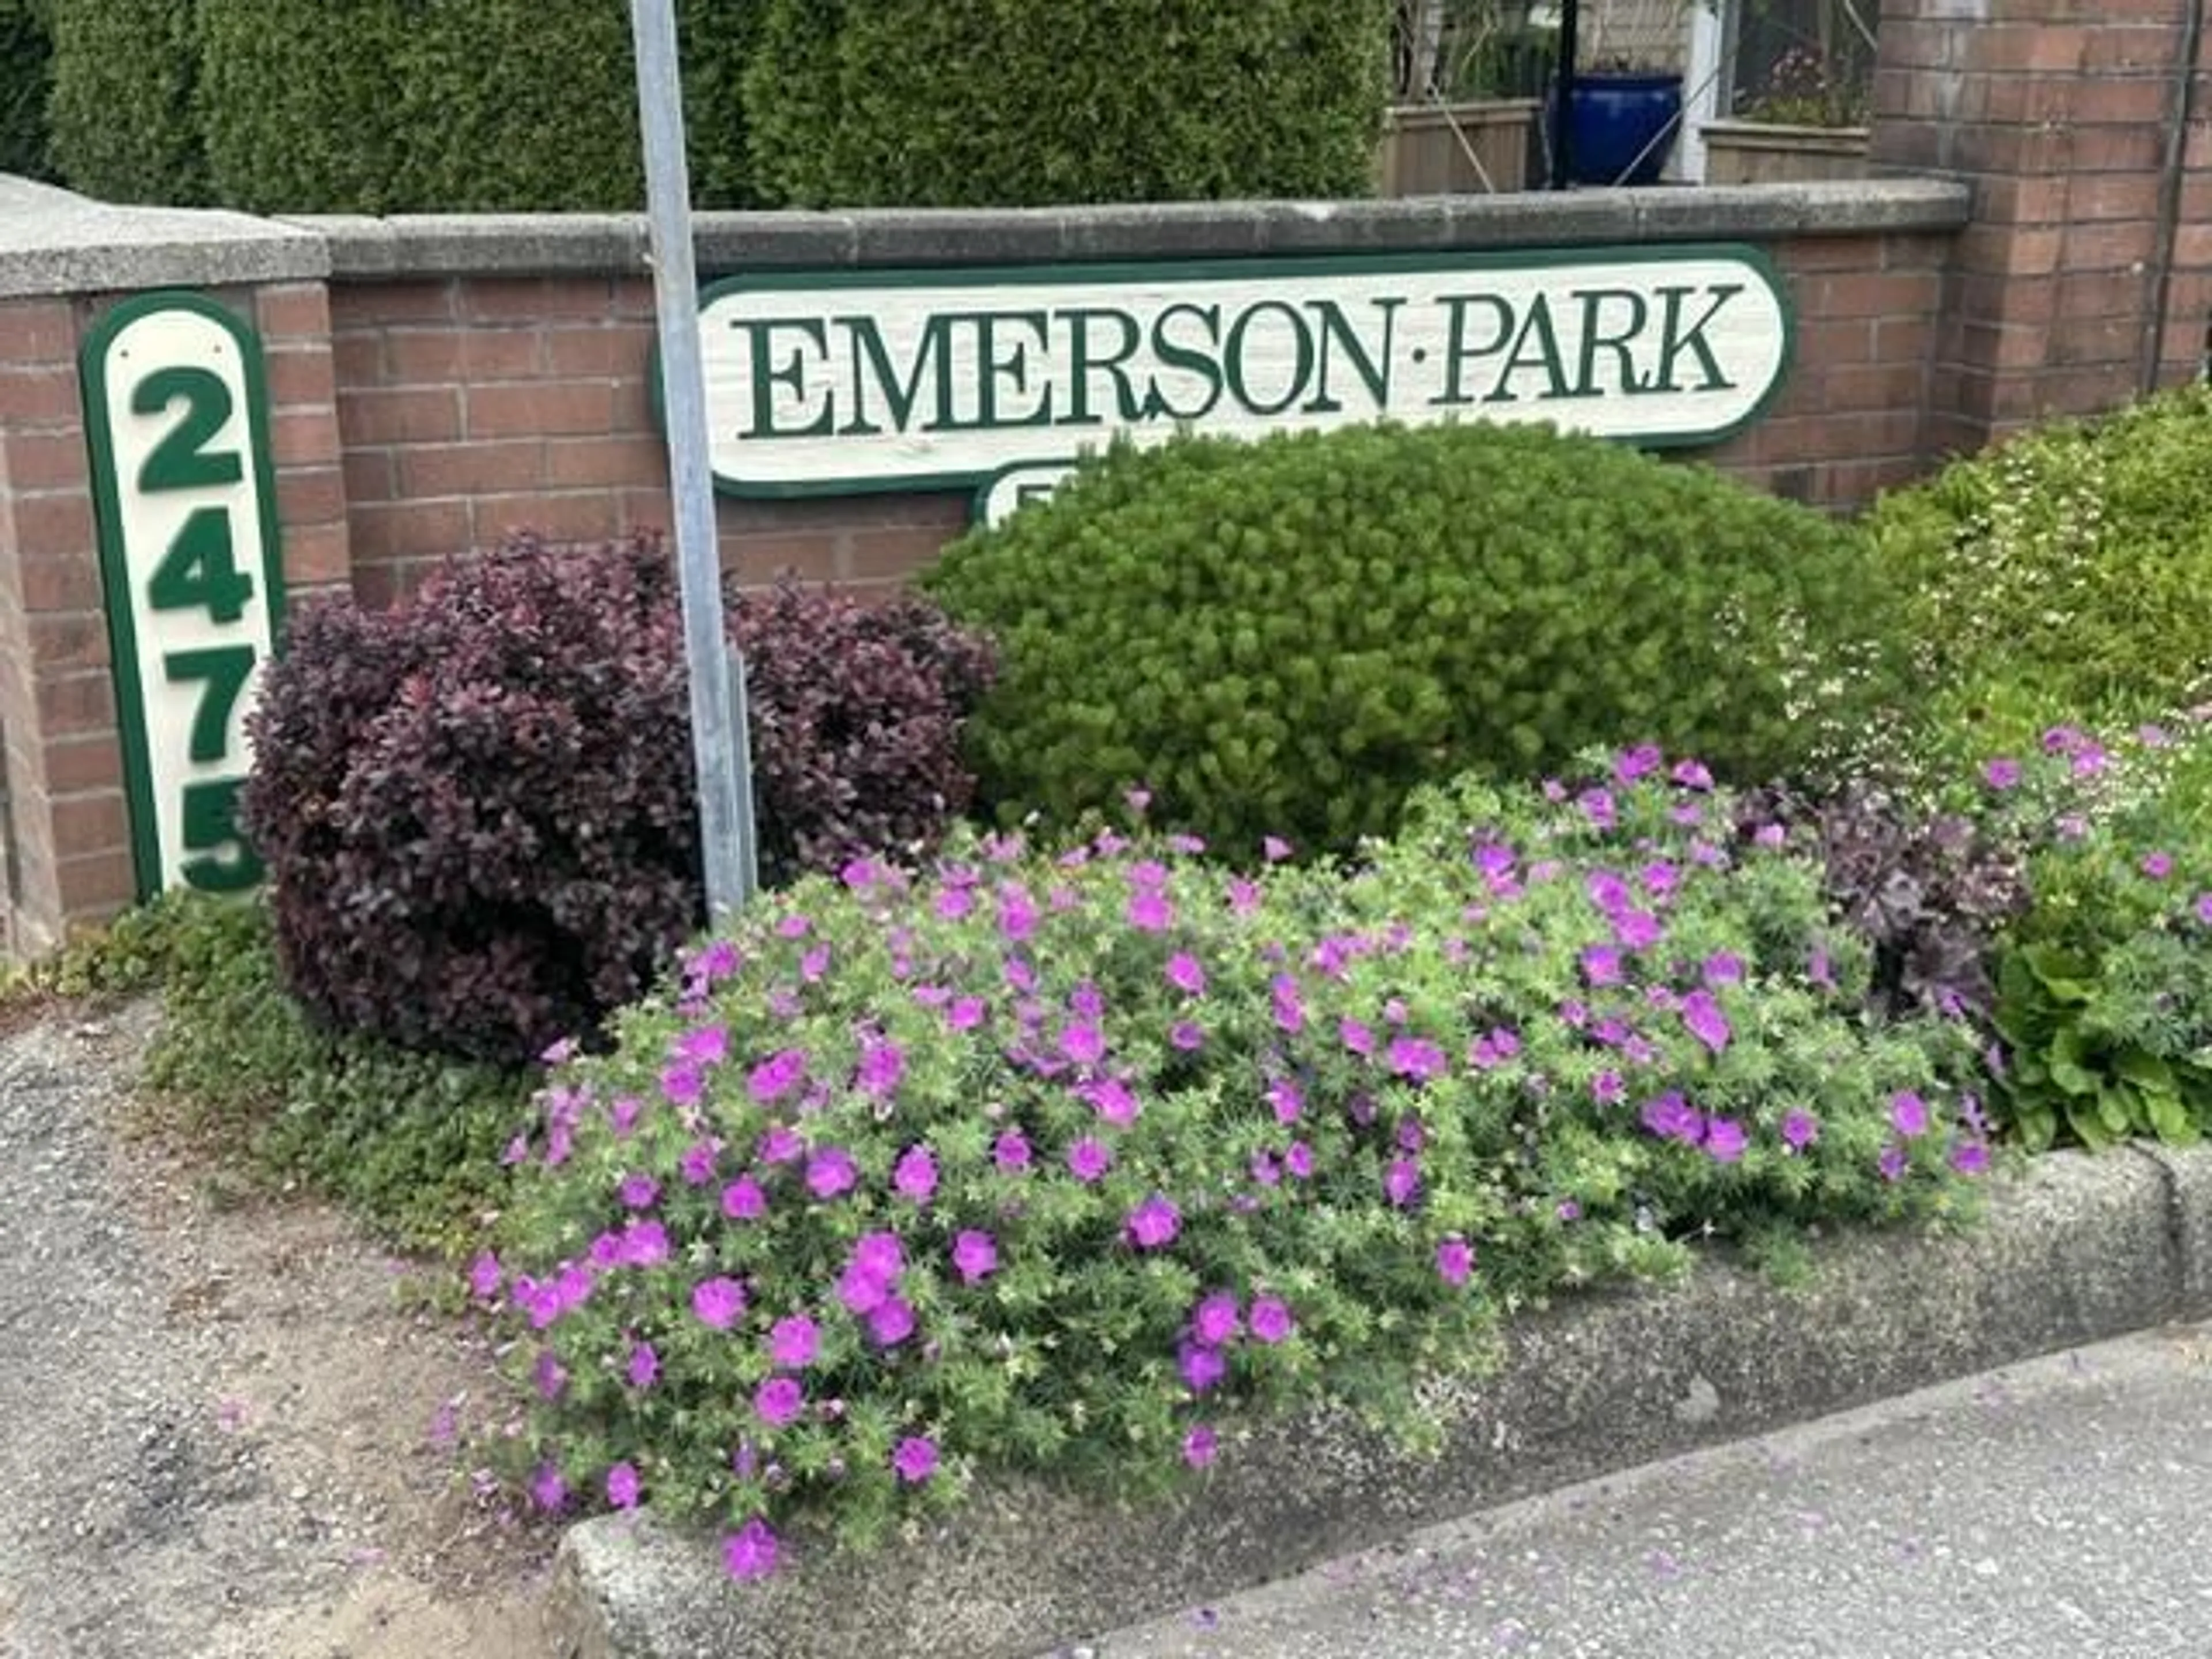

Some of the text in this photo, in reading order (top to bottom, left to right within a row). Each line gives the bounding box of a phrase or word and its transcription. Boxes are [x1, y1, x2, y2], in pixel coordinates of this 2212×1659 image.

[730, 284, 1744, 440] EMERSON PARK
[131, 365, 266, 892] 2475
